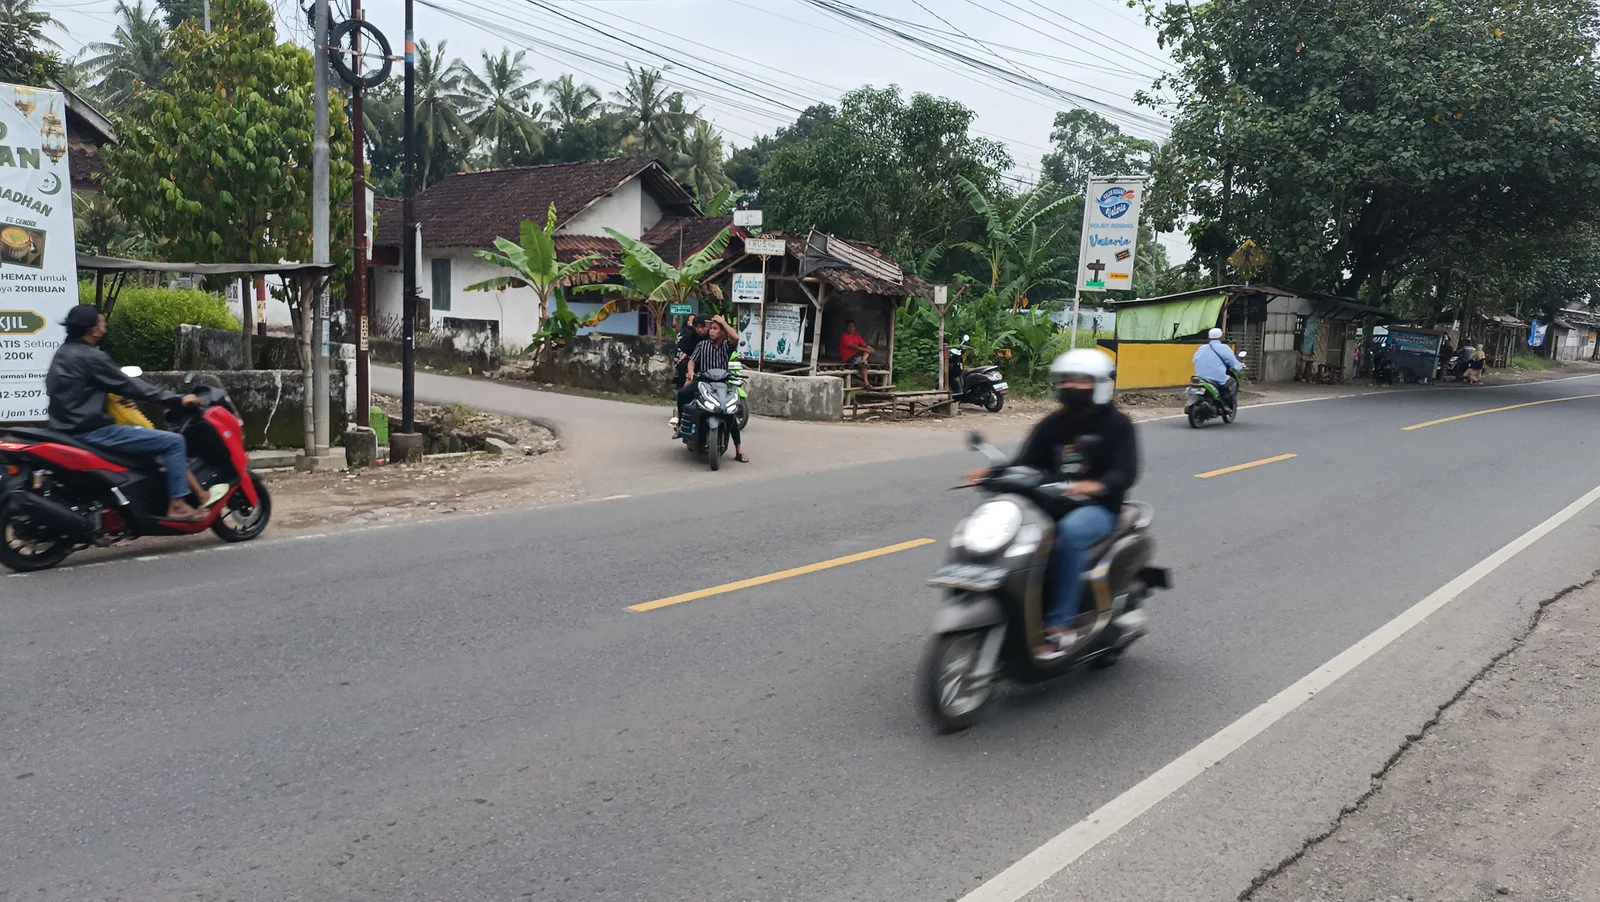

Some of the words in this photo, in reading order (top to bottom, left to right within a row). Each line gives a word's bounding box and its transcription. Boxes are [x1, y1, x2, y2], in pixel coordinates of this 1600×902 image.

[0, 186, 53, 217] ADHAN
[1089, 233, 1132, 247] Valerie
[1, 273, 38, 281] HEMAT
[39, 274, 68, 282] untuk
[14, 285, 66, 293] 20RIBUAN
[23, 339, 60, 350] Setiap
[4, 351, 34, 361] 200K
[5, 409, 26, 419] Jam
